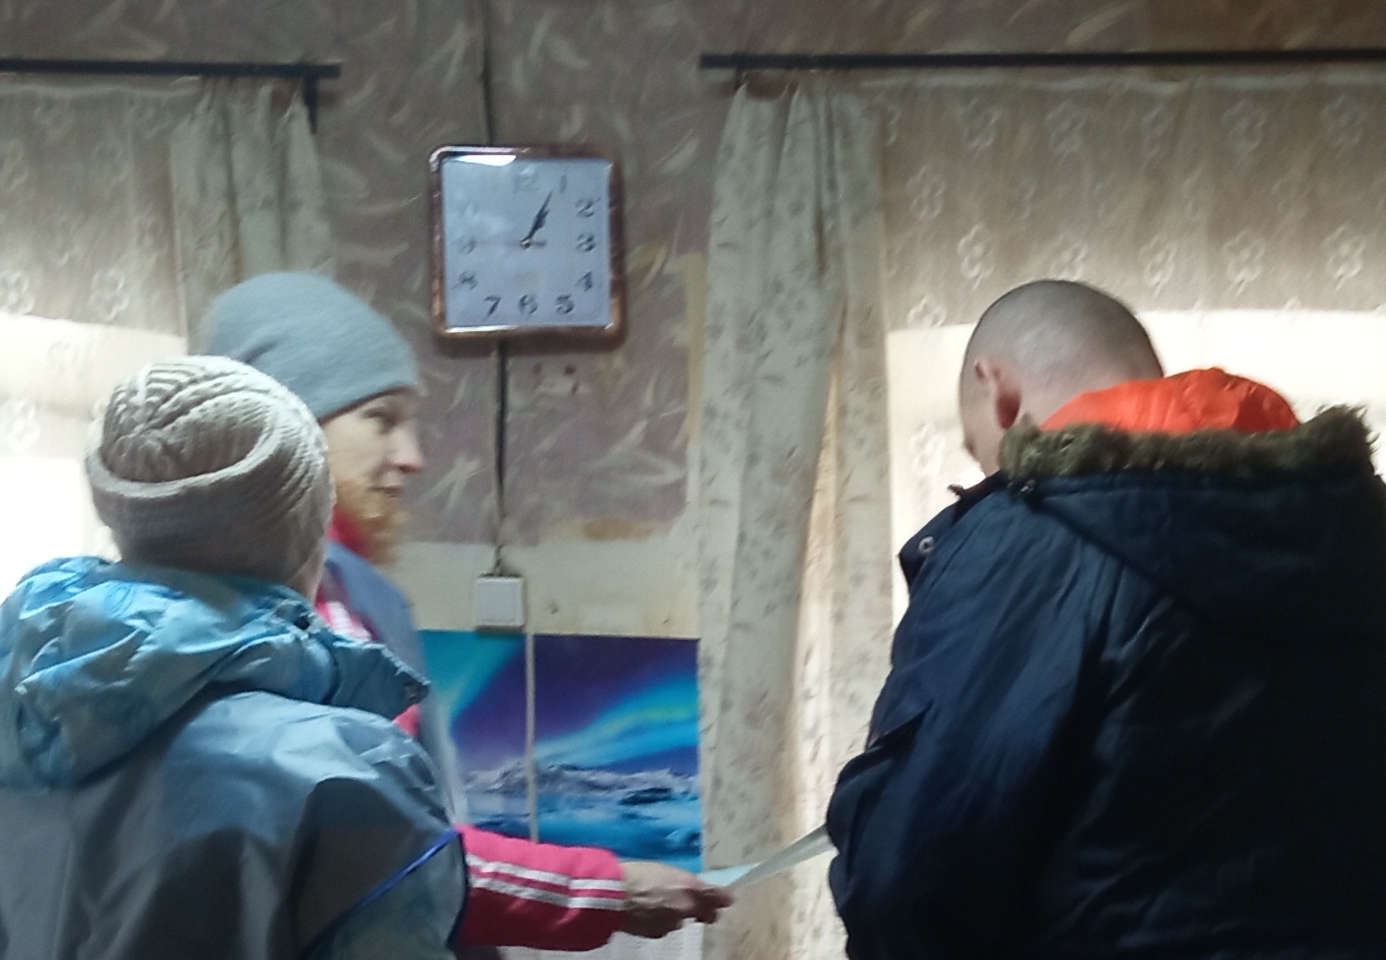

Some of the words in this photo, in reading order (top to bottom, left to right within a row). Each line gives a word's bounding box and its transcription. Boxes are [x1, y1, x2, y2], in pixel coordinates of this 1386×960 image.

[576, 198, 596, 218] 2
[576, 233, 596, 252] 3
[482, 295, 502, 318] 7
[518, 294, 539, 316] 6
[555, 294, 576, 315] 5
